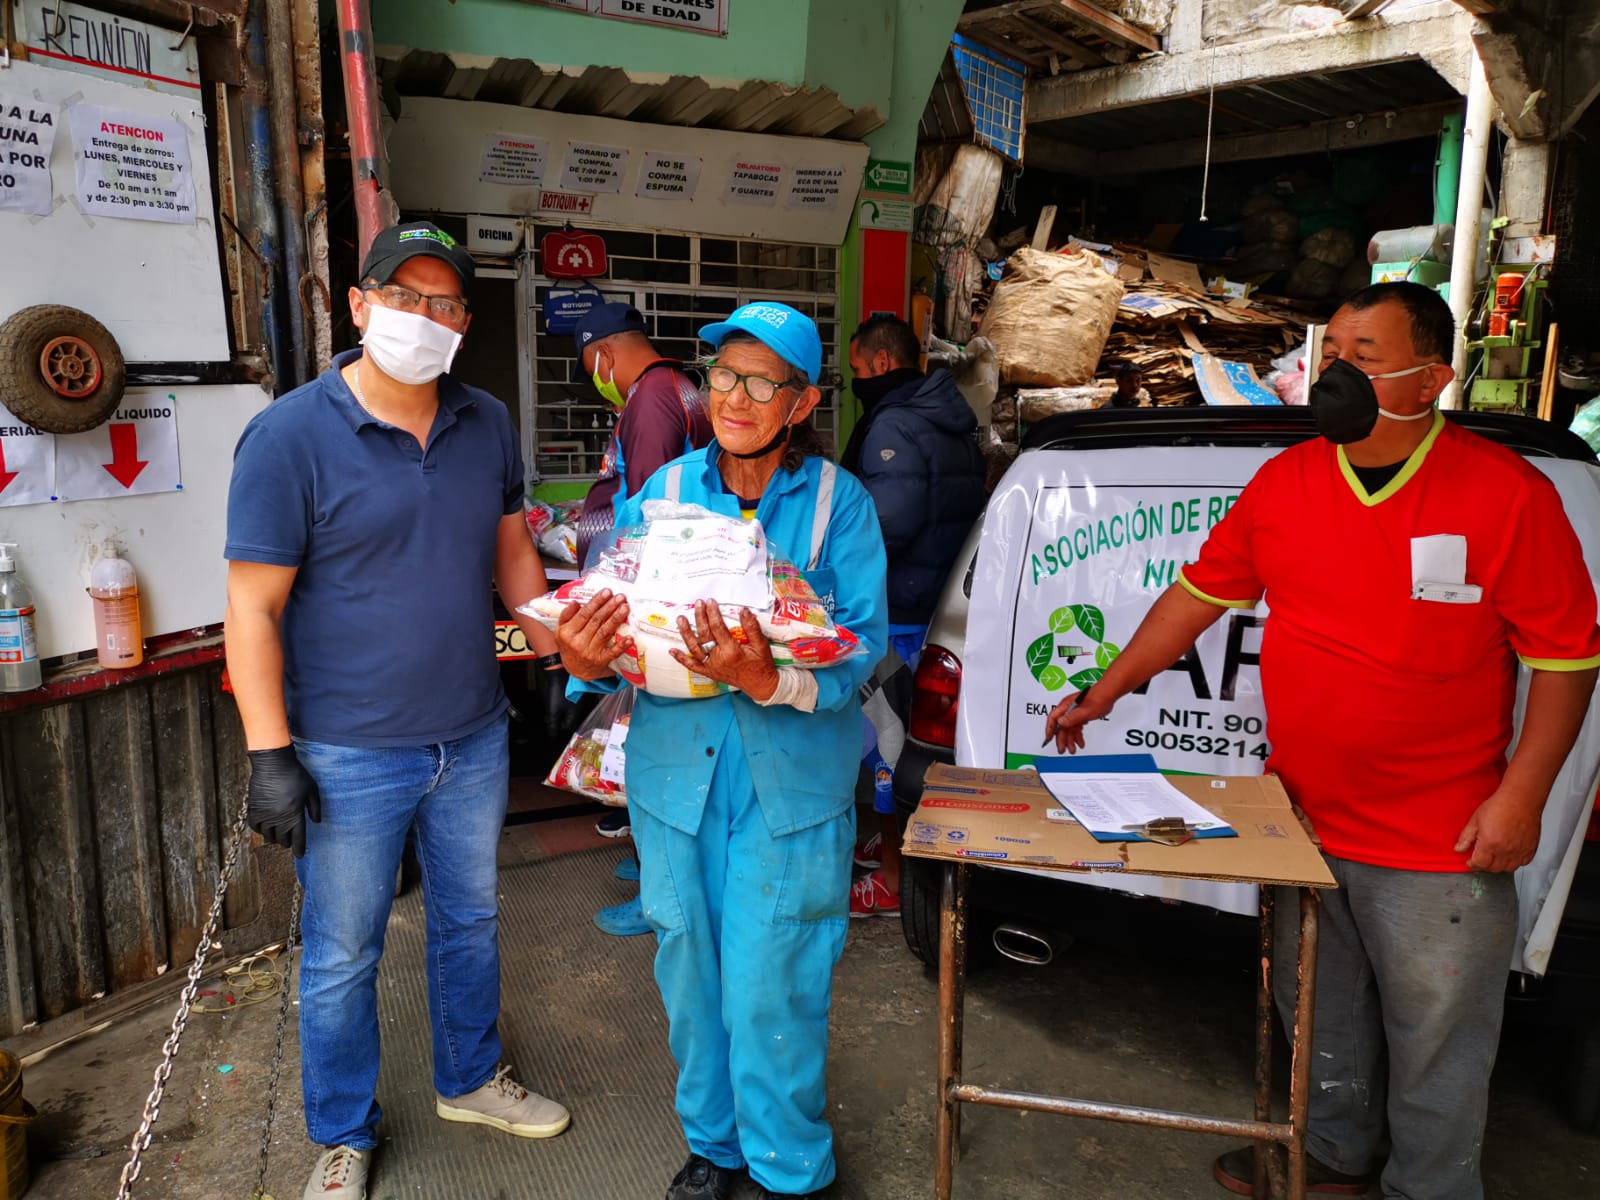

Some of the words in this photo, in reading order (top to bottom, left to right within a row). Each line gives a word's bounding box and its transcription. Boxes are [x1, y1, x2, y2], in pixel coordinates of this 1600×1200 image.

[621, 1, 645, 13] DE
[652, 5, 701, 22] EDAD
[8, 106, 22, 120] A
[29, 110, 53, 127] LA
[0, 126, 39, 146] UNA
[100, 122, 164, 142] ATENCION
[92, 137, 129, 152] Entrega
[131, 144, 142, 153] de
[144, 147, 175, 158] zorros:
[499, 140, 535, 149] ATENCION
[9, 152, 46, 169] POR
[573, 148, 609, 158] HORARIO
[84, 150, 120, 164] LUNES,
[122, 155, 175, 171] MIERCOLES
[177, 164, 183, 172] Y
[578, 158, 613, 167] COMPRA:
[656, 160, 670, 169] NO
[672, 161, 685, 170] SE
[736, 162, 781, 173] OBLIGATORIO
[117, 169, 157, 182] VIERNES
[648, 171, 688, 182] COMPRA
[733, 171, 779, 183] TAPABOCAS
[98, 180, 111, 189] De
[114, 182, 125, 191] 10
[128, 185, 142, 193] am
[152, 187, 162, 196] 11
[164, 189, 177, 198] am
[646, 182, 684, 193] ESPUMA
[738, 187, 774, 197] GUANTES
[87, 193, 93, 203] y
[95, 193, 107, 203] de
[110, 194, 130, 205] 2:30
[133, 198, 147, 207] pm
[156, 200, 174, 210] 3:30
[177, 204, 190, 212] pm
[541, 193, 579, 211] BOTIQUIN
[478, 228, 513, 242] OFICINA
[116, 408, 172, 420] LIQUIDO
[1031, 501, 1164, 587] ASOCIACIÓN
[1171, 498, 1201, 535] DE
[1026, 702, 1049, 716] EKA
[1159, 708, 1213, 731] NIT.
[1125, 729, 1269, 761] S0053214
